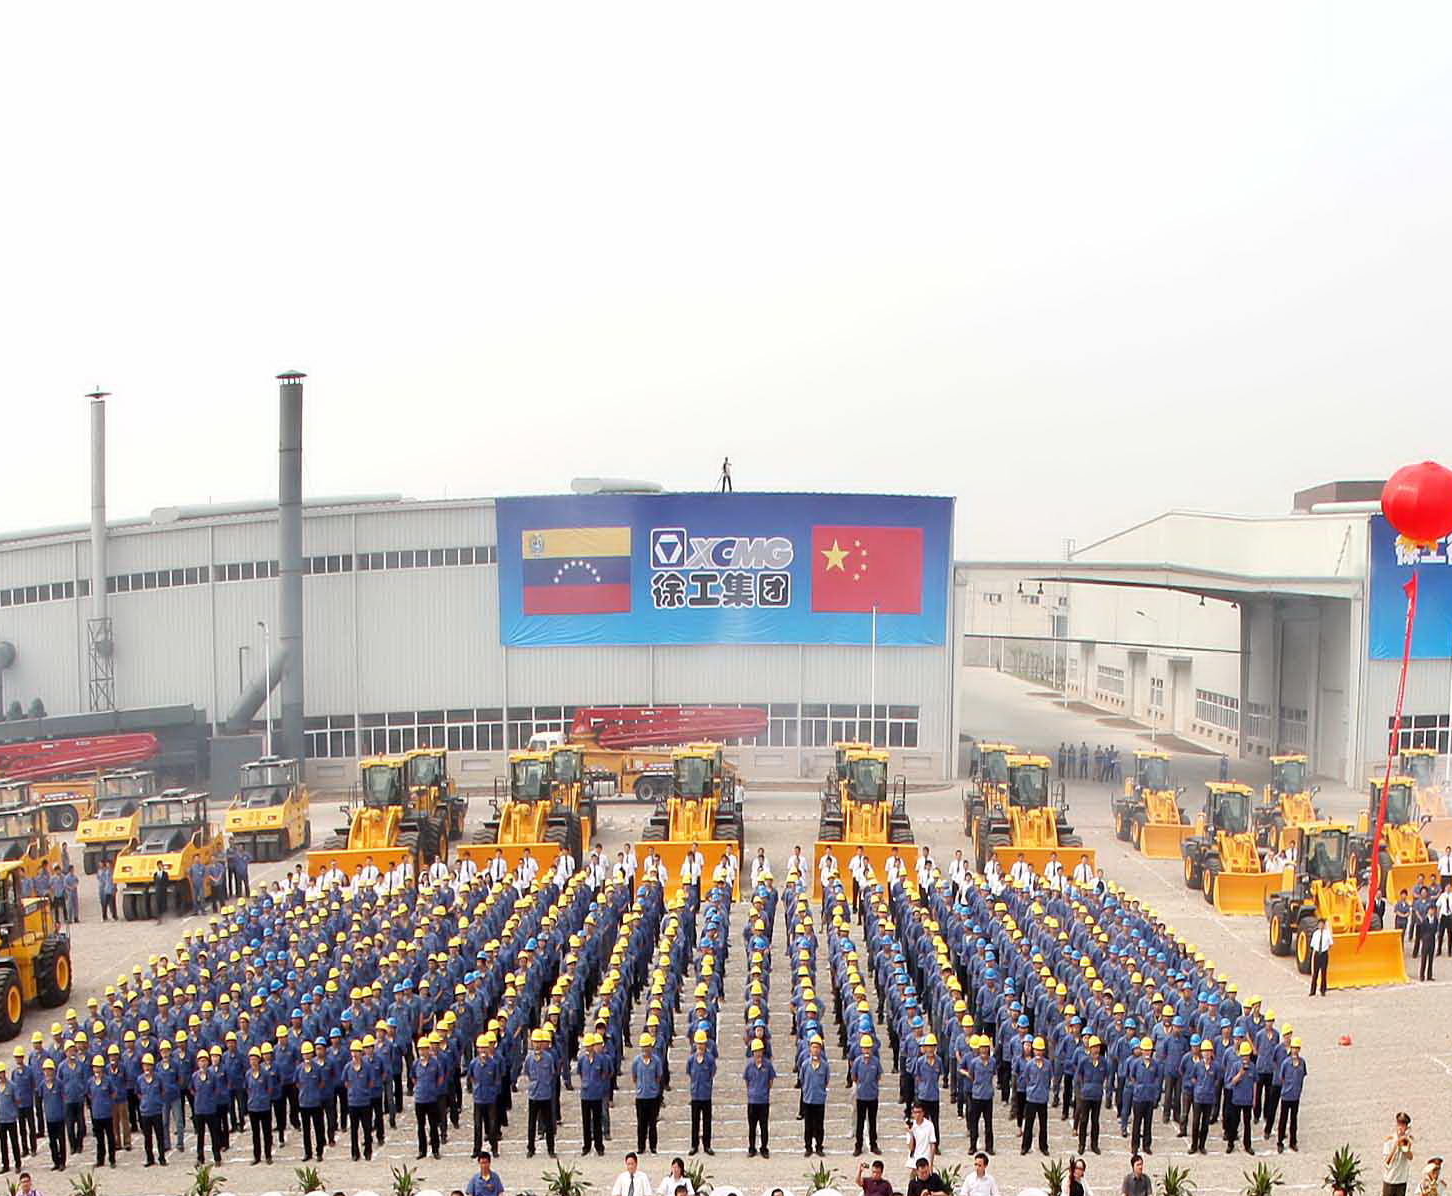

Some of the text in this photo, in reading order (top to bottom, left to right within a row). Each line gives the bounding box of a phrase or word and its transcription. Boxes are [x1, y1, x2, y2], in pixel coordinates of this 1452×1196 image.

[687, 537, 794, 570] XCMG
[651, 572, 792, 609] 徐工集团
